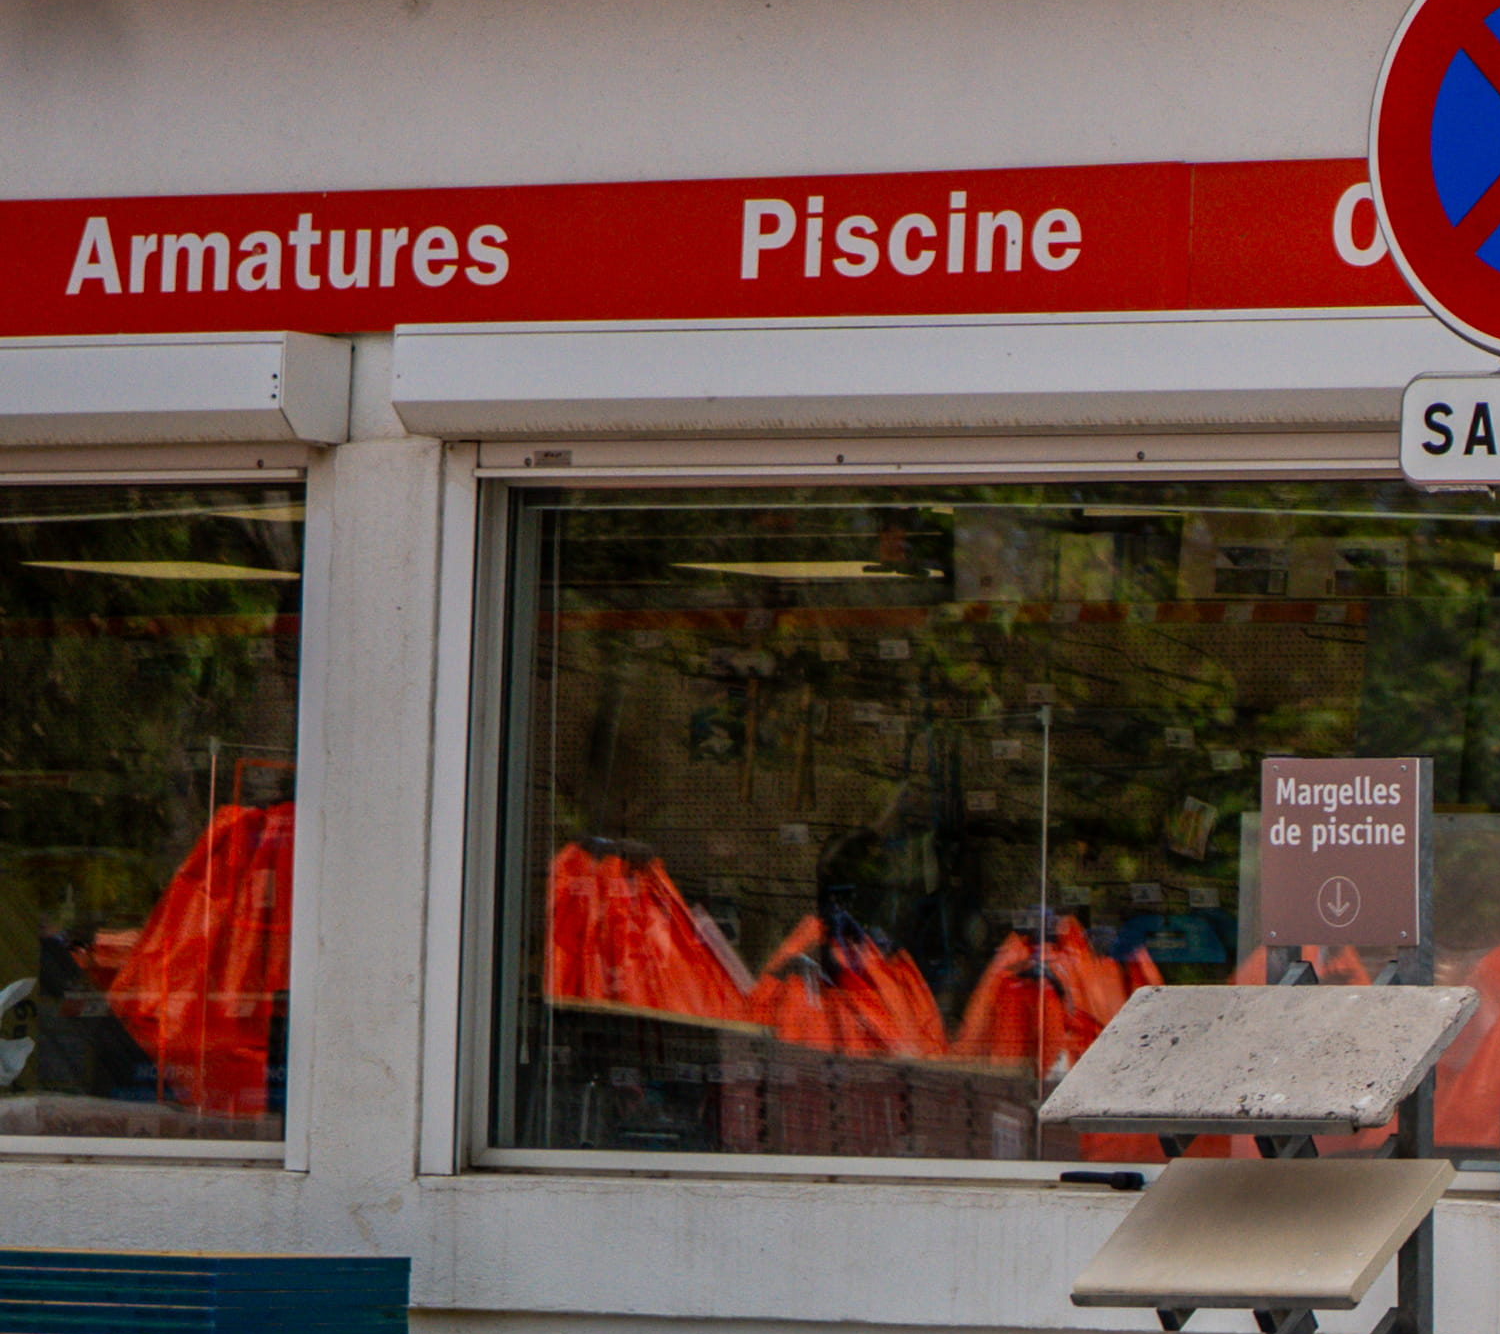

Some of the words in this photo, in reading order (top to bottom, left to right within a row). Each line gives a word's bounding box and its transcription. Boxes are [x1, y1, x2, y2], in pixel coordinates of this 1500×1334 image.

[65, 212, 510, 296] Armatures
[740, 190, 1083, 280] Piscine
[1275, 776, 1402, 813] Margelles
[1270, 817, 1302, 846] de
[1312, 816, 1407, 853] piscine
